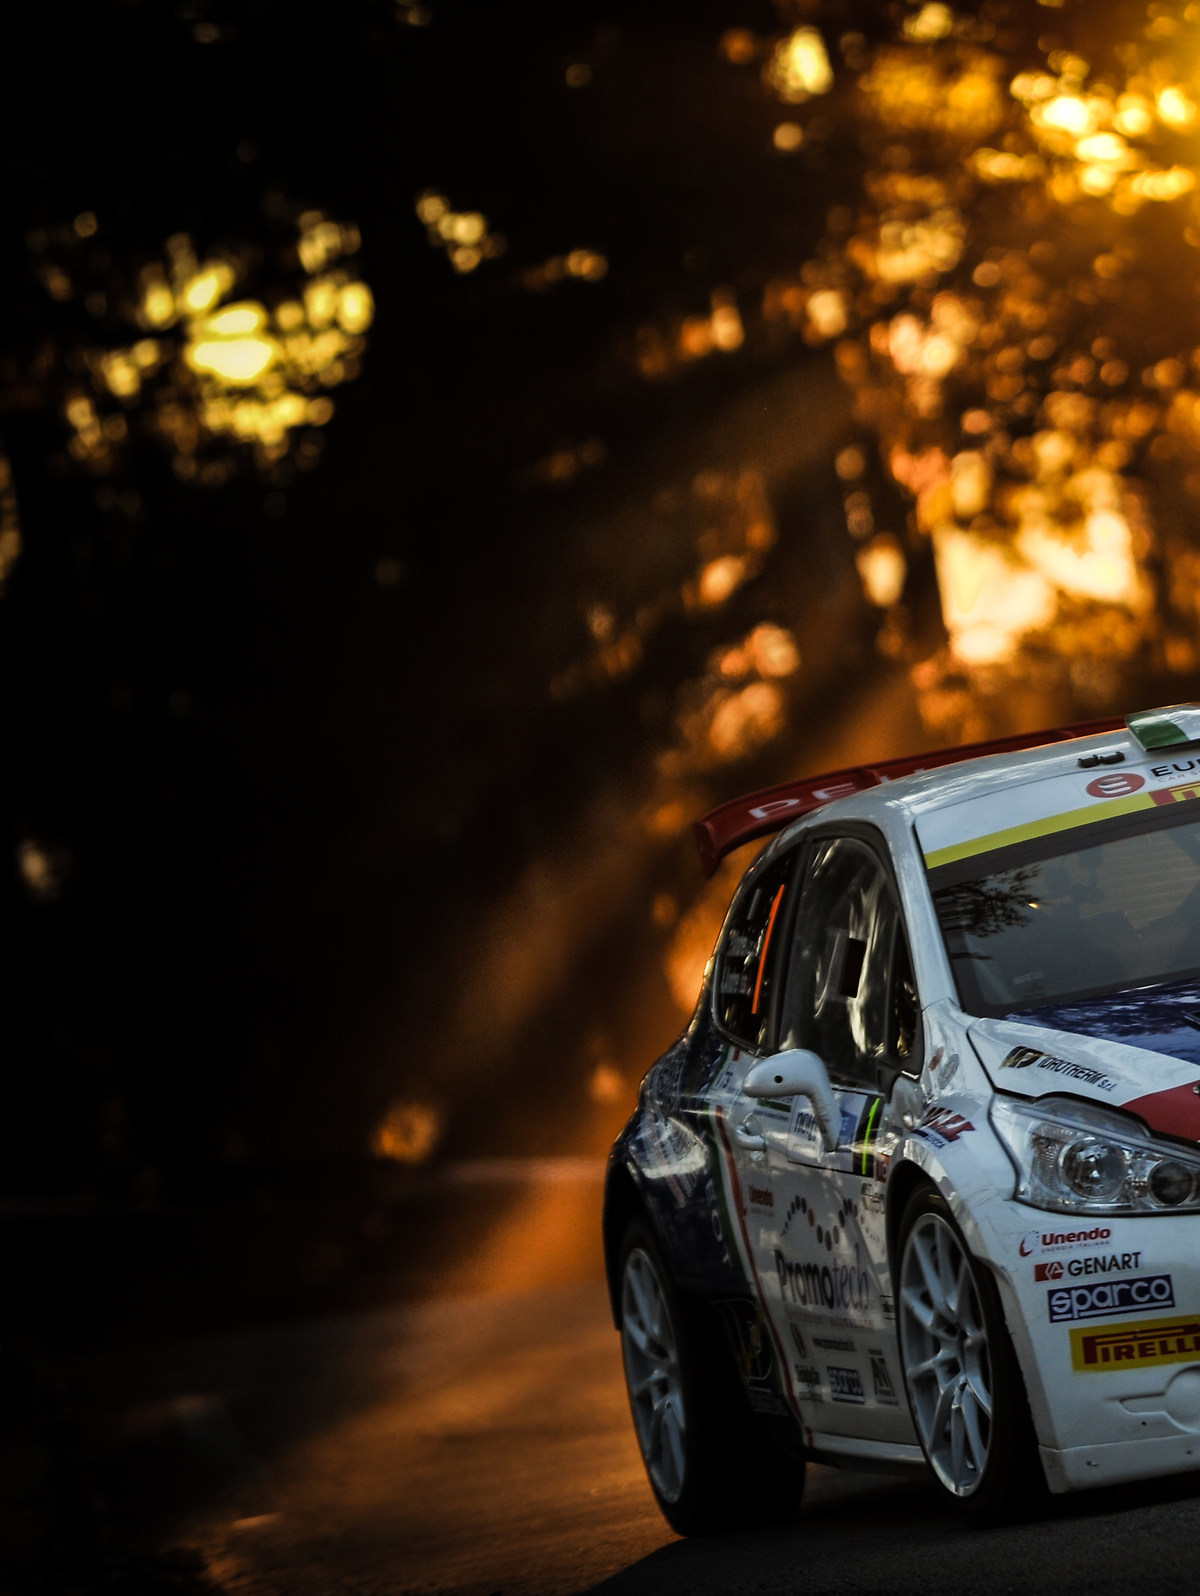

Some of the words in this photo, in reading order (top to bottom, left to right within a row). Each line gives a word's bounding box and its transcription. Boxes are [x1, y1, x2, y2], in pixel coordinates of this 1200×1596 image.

[1041, 1227, 1111, 1246] Unendo
[774, 1243, 869, 1311] Promotech
[1068, 1252, 1141, 1277] GENART
[1051, 1278, 1171, 1318] sparco
